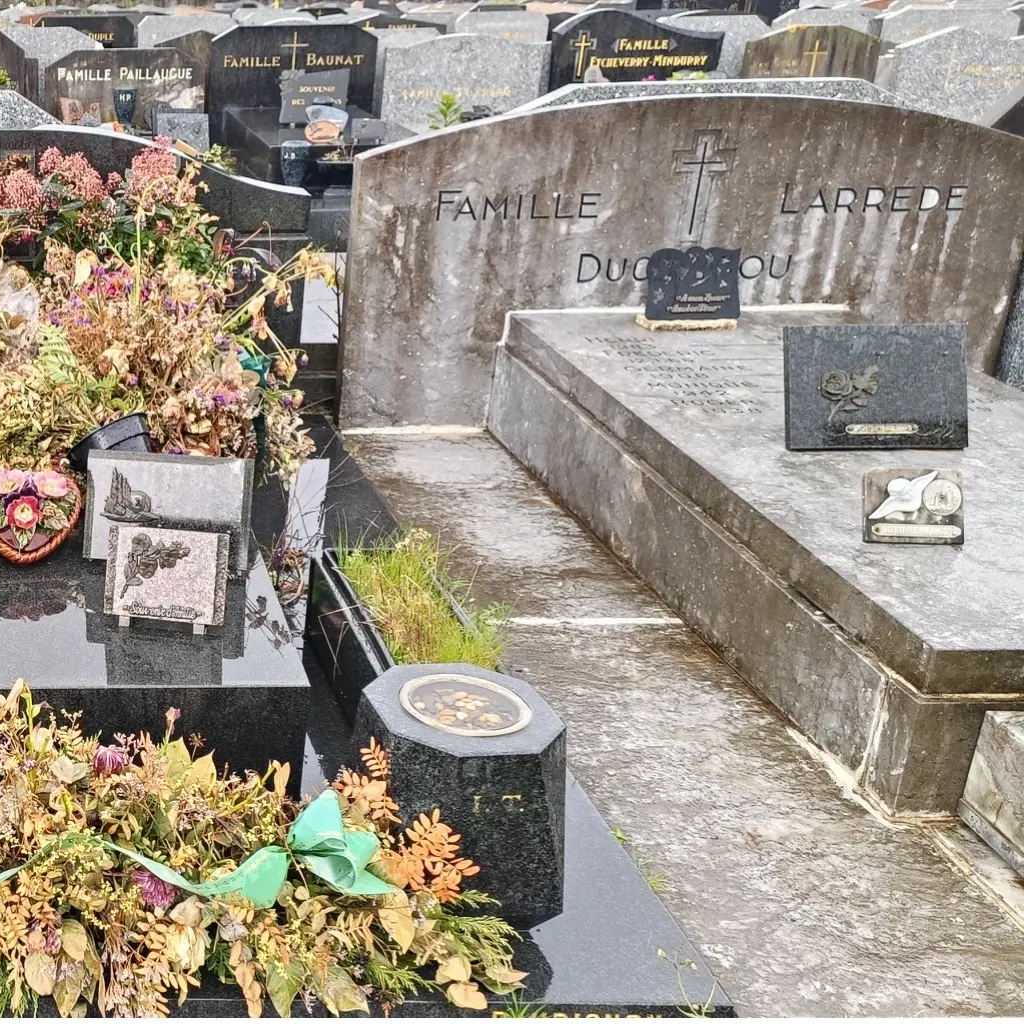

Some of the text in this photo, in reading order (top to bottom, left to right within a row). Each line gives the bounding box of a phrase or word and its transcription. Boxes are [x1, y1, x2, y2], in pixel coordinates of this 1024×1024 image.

[619, 39, 669, 51] FAMILLE
[223, 53, 364, 67] FAMILLE BAUNAT
[57, 67, 112, 81] FAMILLE
[435, 182, 969, 221] FAMILLE LARREDE
[576, 253, 793, 283] DUCOU
